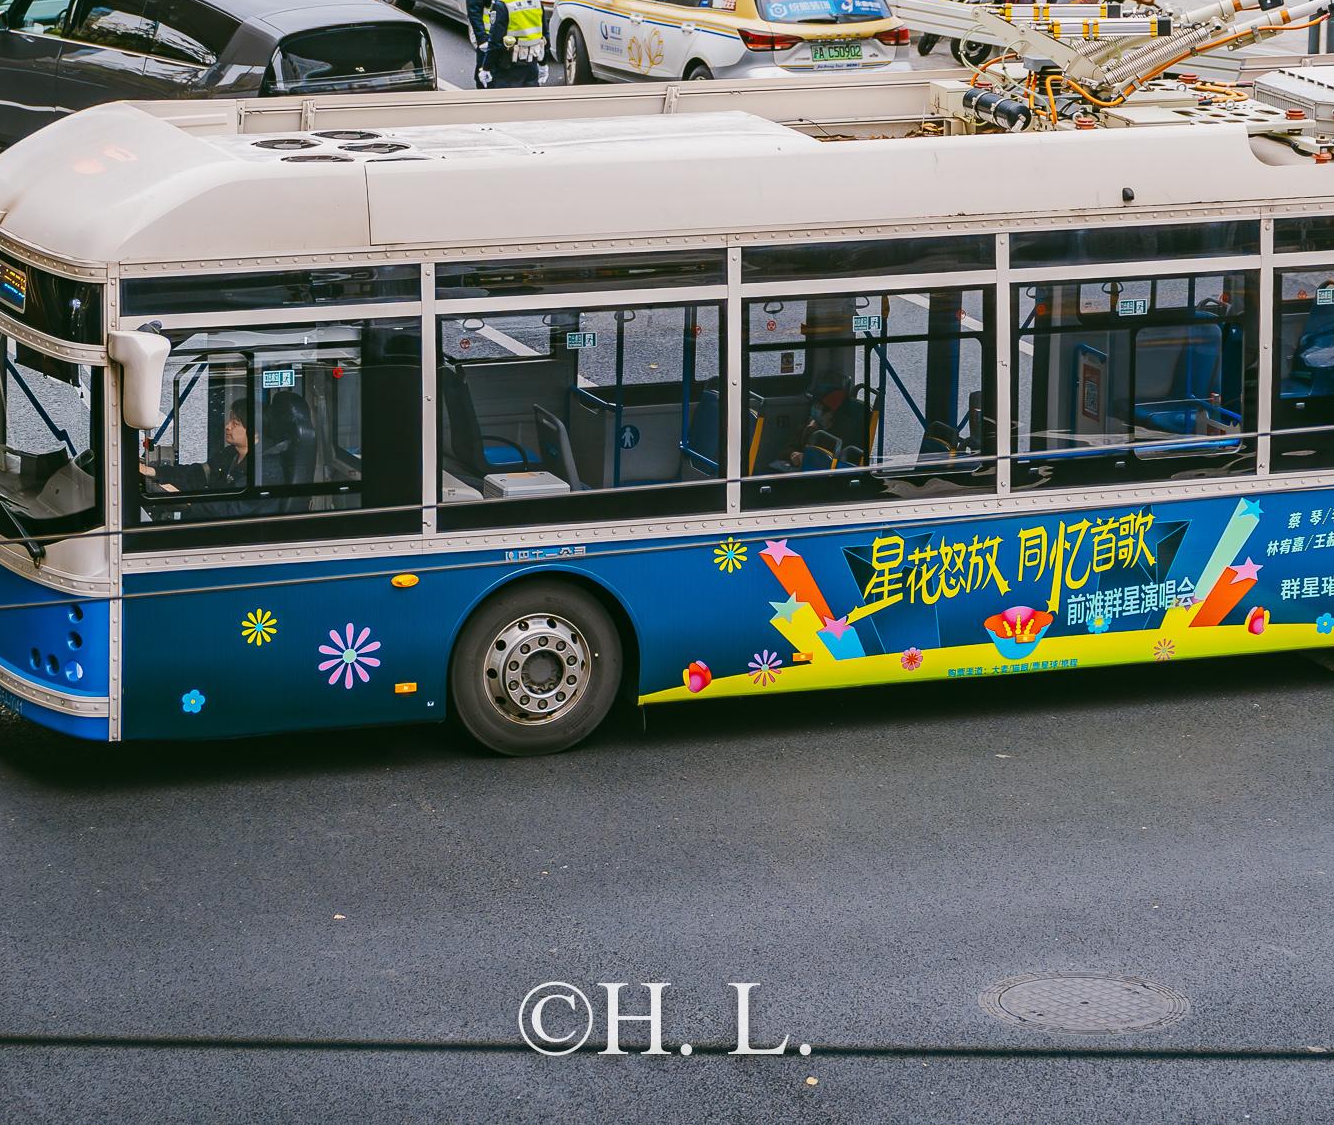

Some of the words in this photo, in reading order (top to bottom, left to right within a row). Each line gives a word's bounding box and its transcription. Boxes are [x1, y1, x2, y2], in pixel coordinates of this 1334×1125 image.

[828, 45, 861, 59] C50902
[1287, 512, 1302, 529] 蔡
[845, 535, 1012, 622] 星花怒放
[1018, 509, 1157, 615] 同忆首歌
[1067, 576, 1196, 626] 前滩群星演唱会
